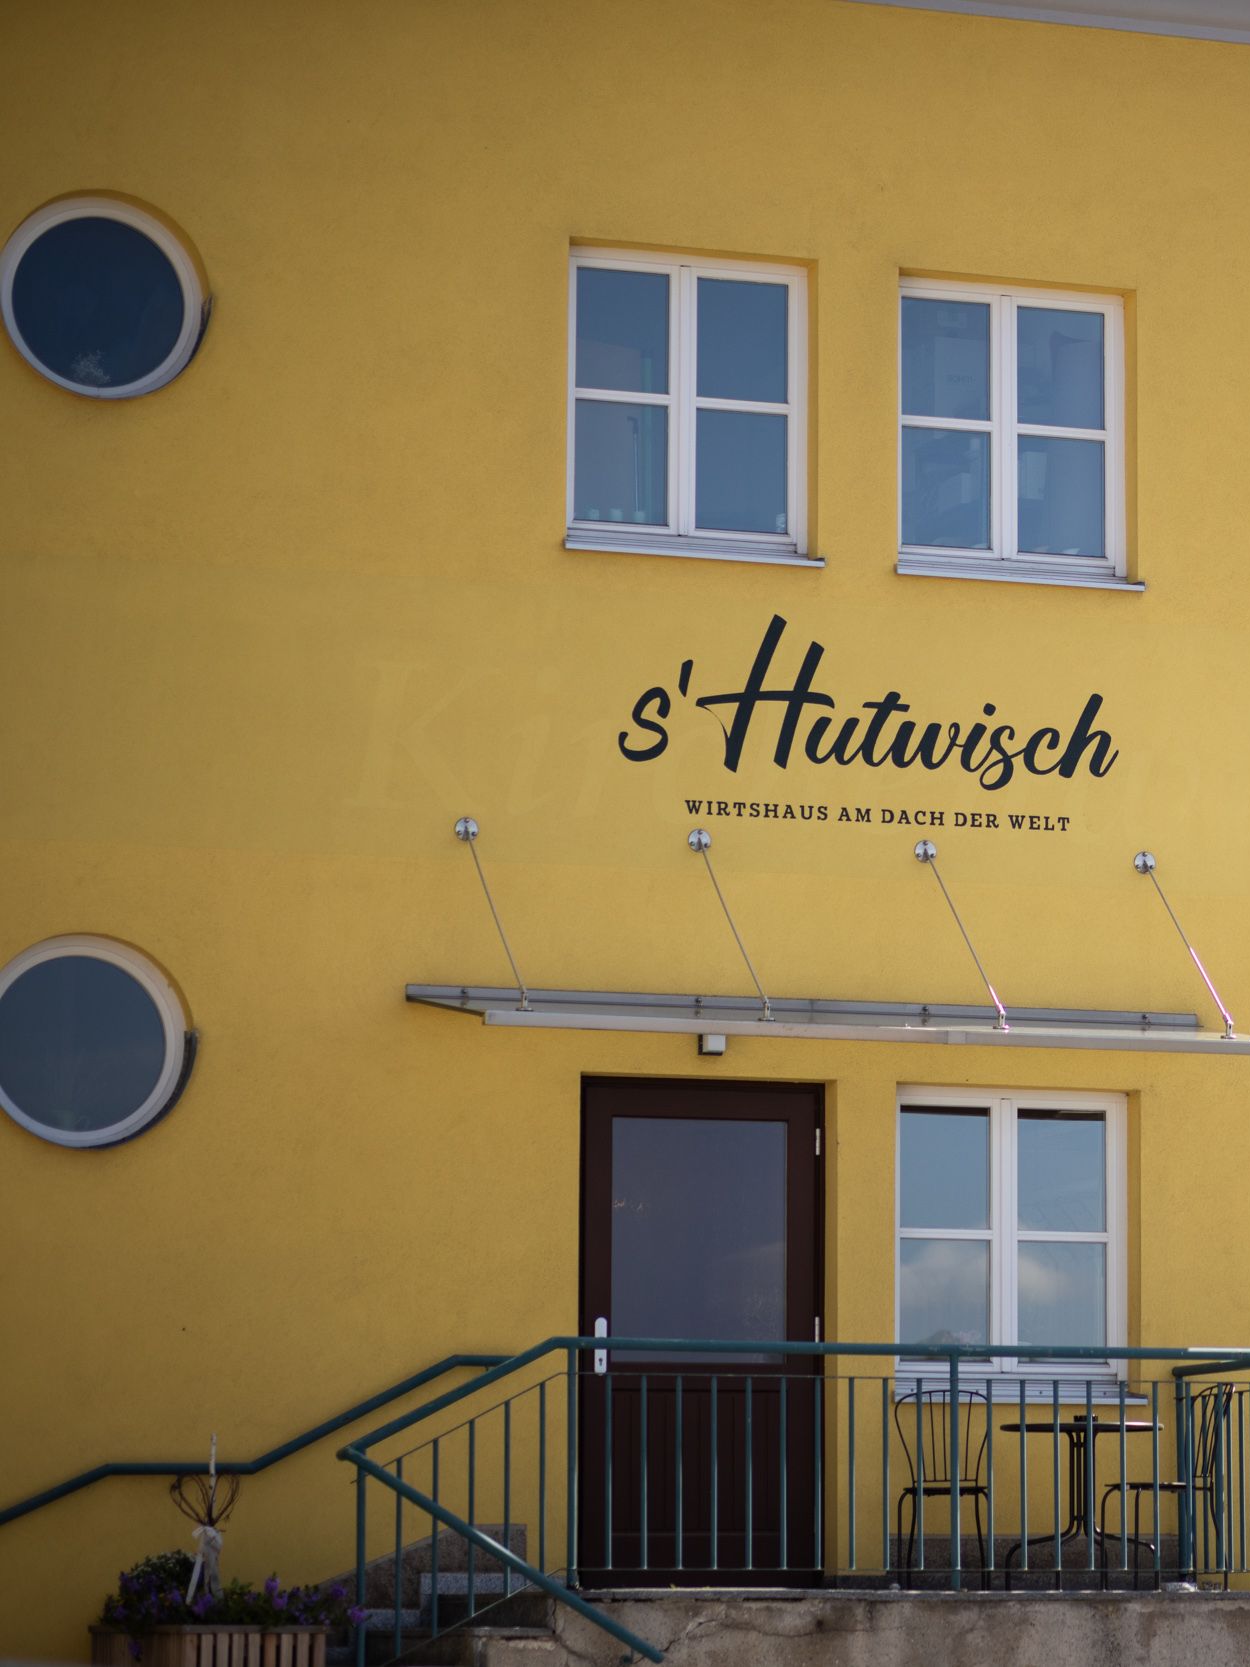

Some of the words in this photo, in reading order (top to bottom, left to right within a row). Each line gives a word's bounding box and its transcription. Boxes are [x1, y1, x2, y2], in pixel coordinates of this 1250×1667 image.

[684, 799, 828, 821] WIRTSHAUS
[837, 806, 872, 823] AM
[880, 808, 945, 826] DACH
[954, 812, 1000, 829] DER
[1008, 814, 1070, 832] WELT
